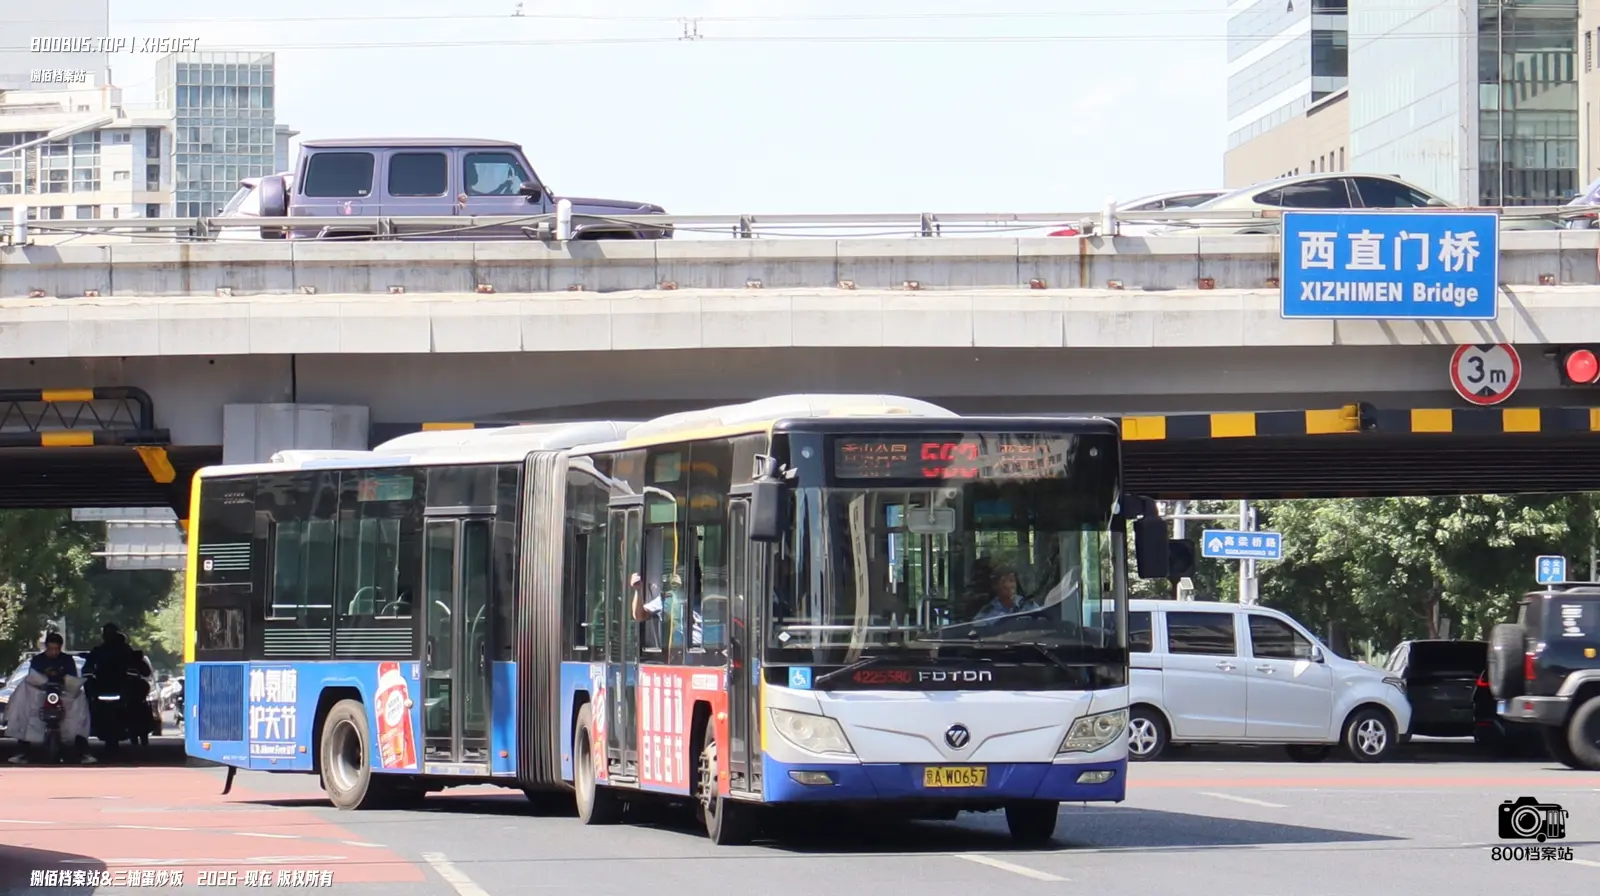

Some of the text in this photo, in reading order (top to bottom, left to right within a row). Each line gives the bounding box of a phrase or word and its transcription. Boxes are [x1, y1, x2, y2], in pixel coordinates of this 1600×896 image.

[1298, 229, 1481, 273] 西直门桥
[1300, 281, 1479, 307] XIZHIMEN Bridge
[918, 670, 993, 682] FOTON
[249, 704, 298, 740] 护关节
